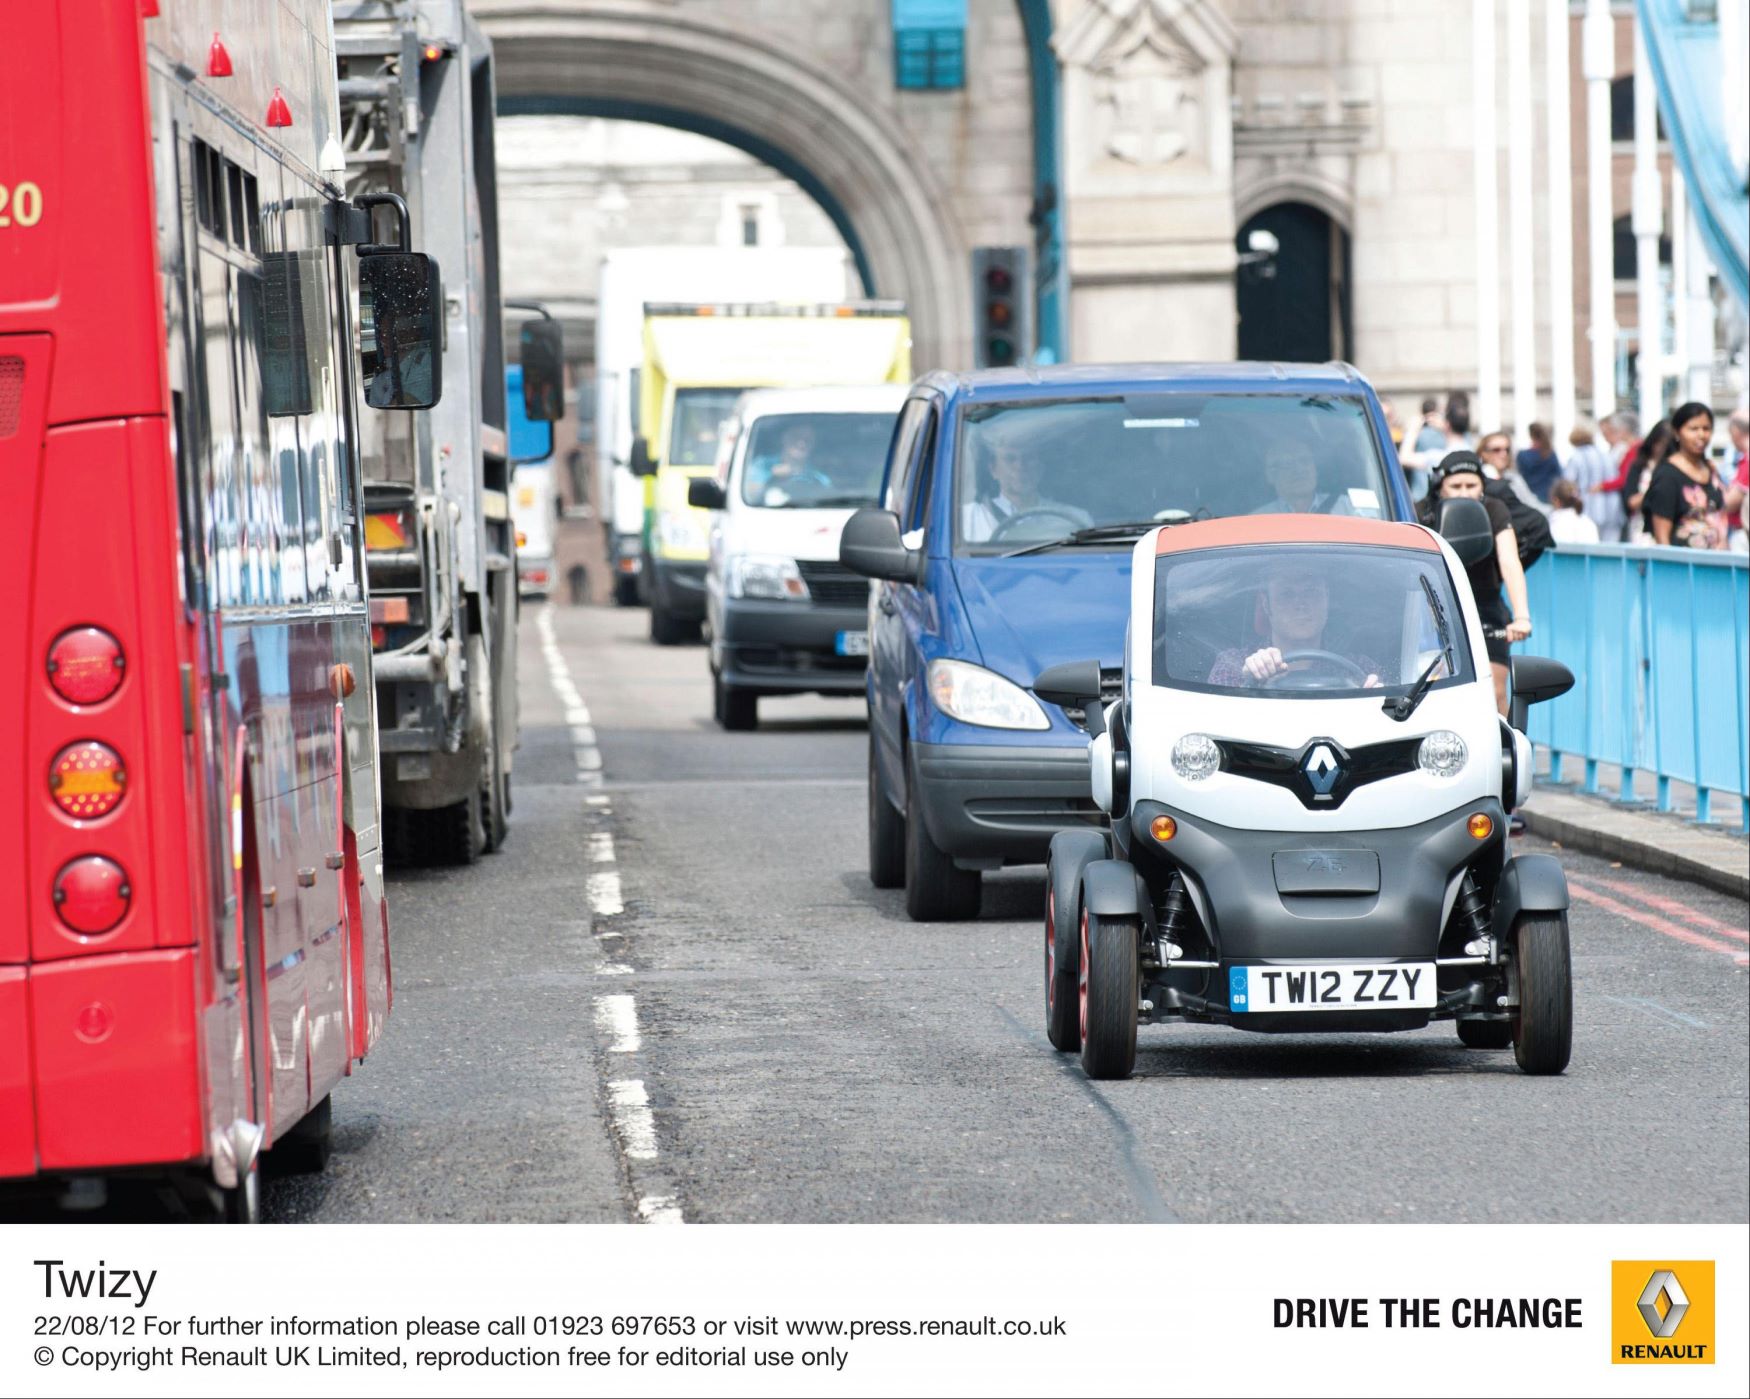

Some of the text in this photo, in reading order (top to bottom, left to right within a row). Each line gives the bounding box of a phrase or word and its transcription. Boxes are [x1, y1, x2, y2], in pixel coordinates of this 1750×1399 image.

[1261, 968, 1422, 1004] TW12 ZZY
[1233, 994, 1246, 1004] GB
